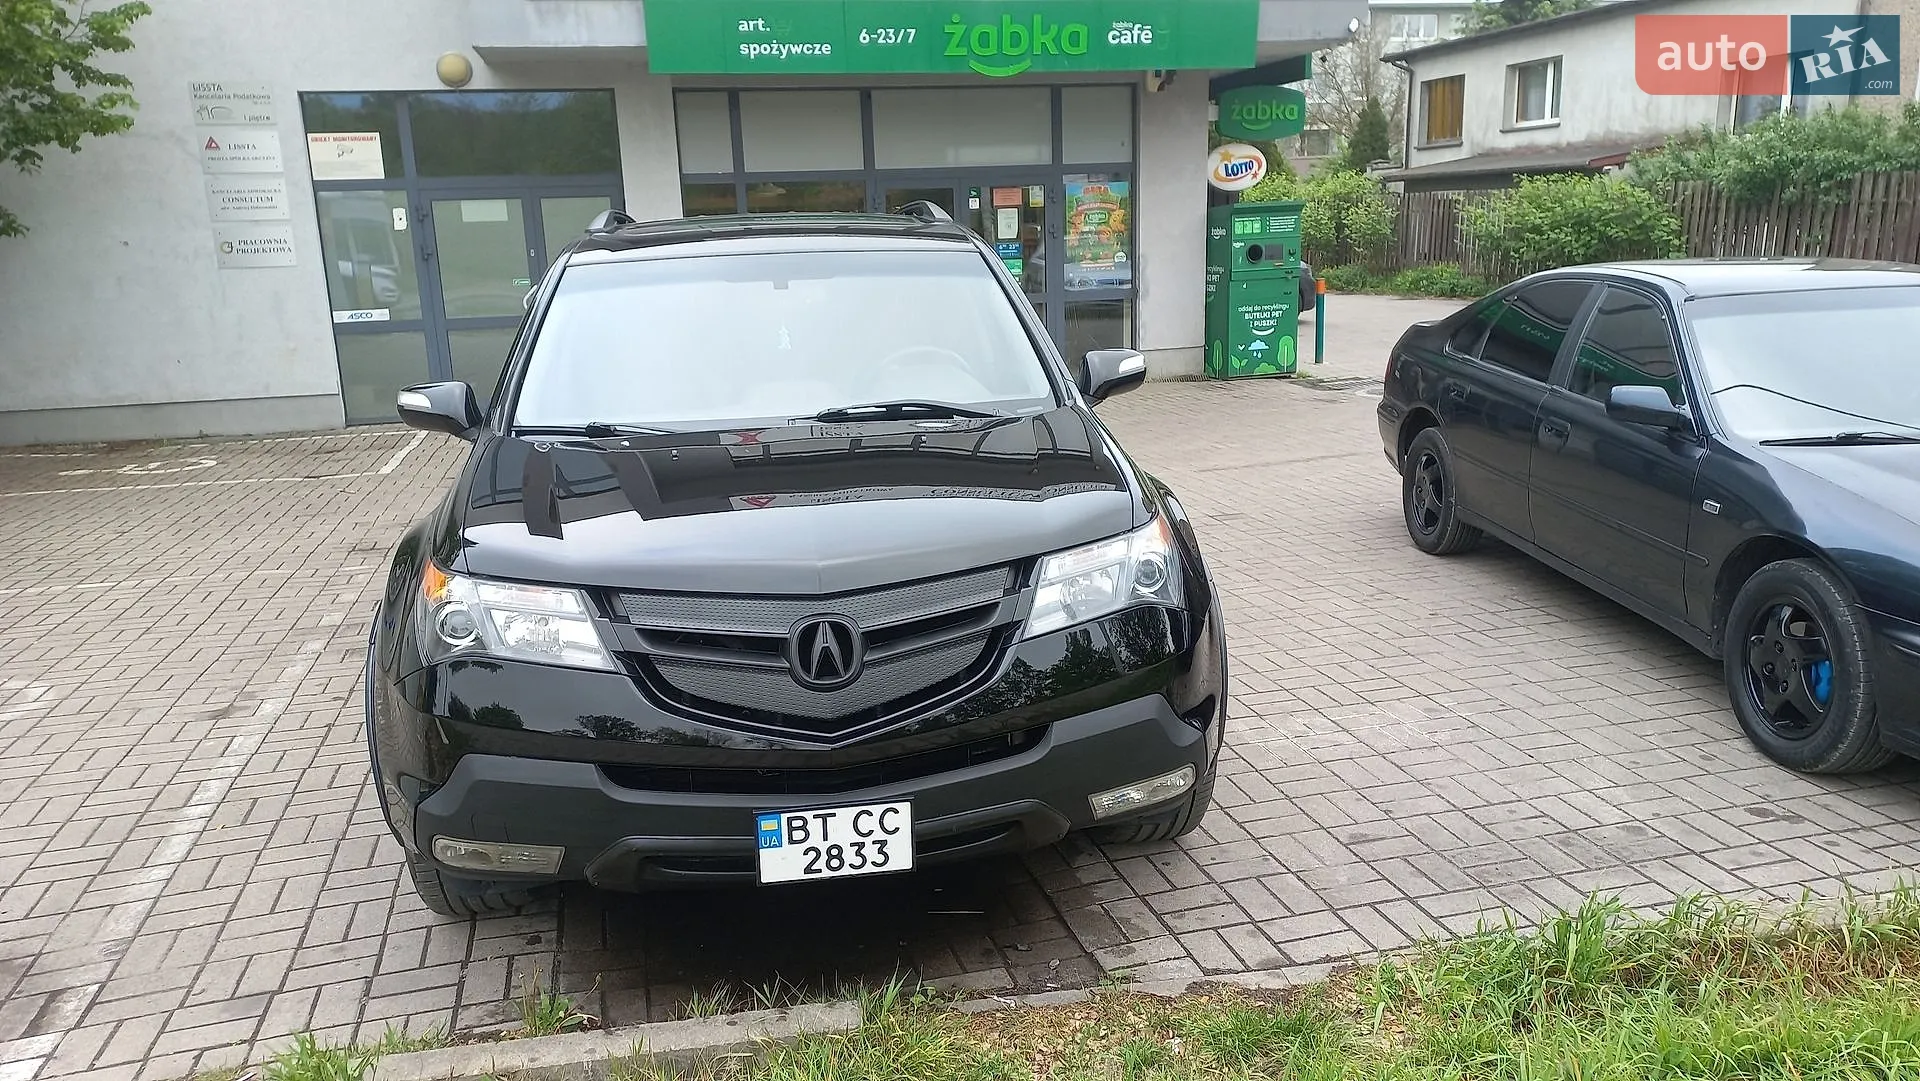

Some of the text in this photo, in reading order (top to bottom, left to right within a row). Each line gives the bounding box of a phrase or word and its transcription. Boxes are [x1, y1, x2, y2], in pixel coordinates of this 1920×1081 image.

[738, 17, 771, 32] art.
[859, 28, 917, 44] 6-23/7
[943, 13, 1088, 56] żabka
[739, 40, 832, 59] spożywcze
[1231, 99, 1299, 121] żabka
[1224, 159, 1254, 177] LOTTO
[222, 195, 273, 203] CONSULTUM
[238, 238, 288, 246] PRACOWNIA
[236, 246, 292, 255] PROJEKTOWA
[347, 312, 373, 320] ASCO
[1244, 310, 1283, 320] BUTELKI PET
[787, 807, 900, 846] BT CC
[761, 835, 780, 848] UA
[803, 839, 890, 875] 2833
